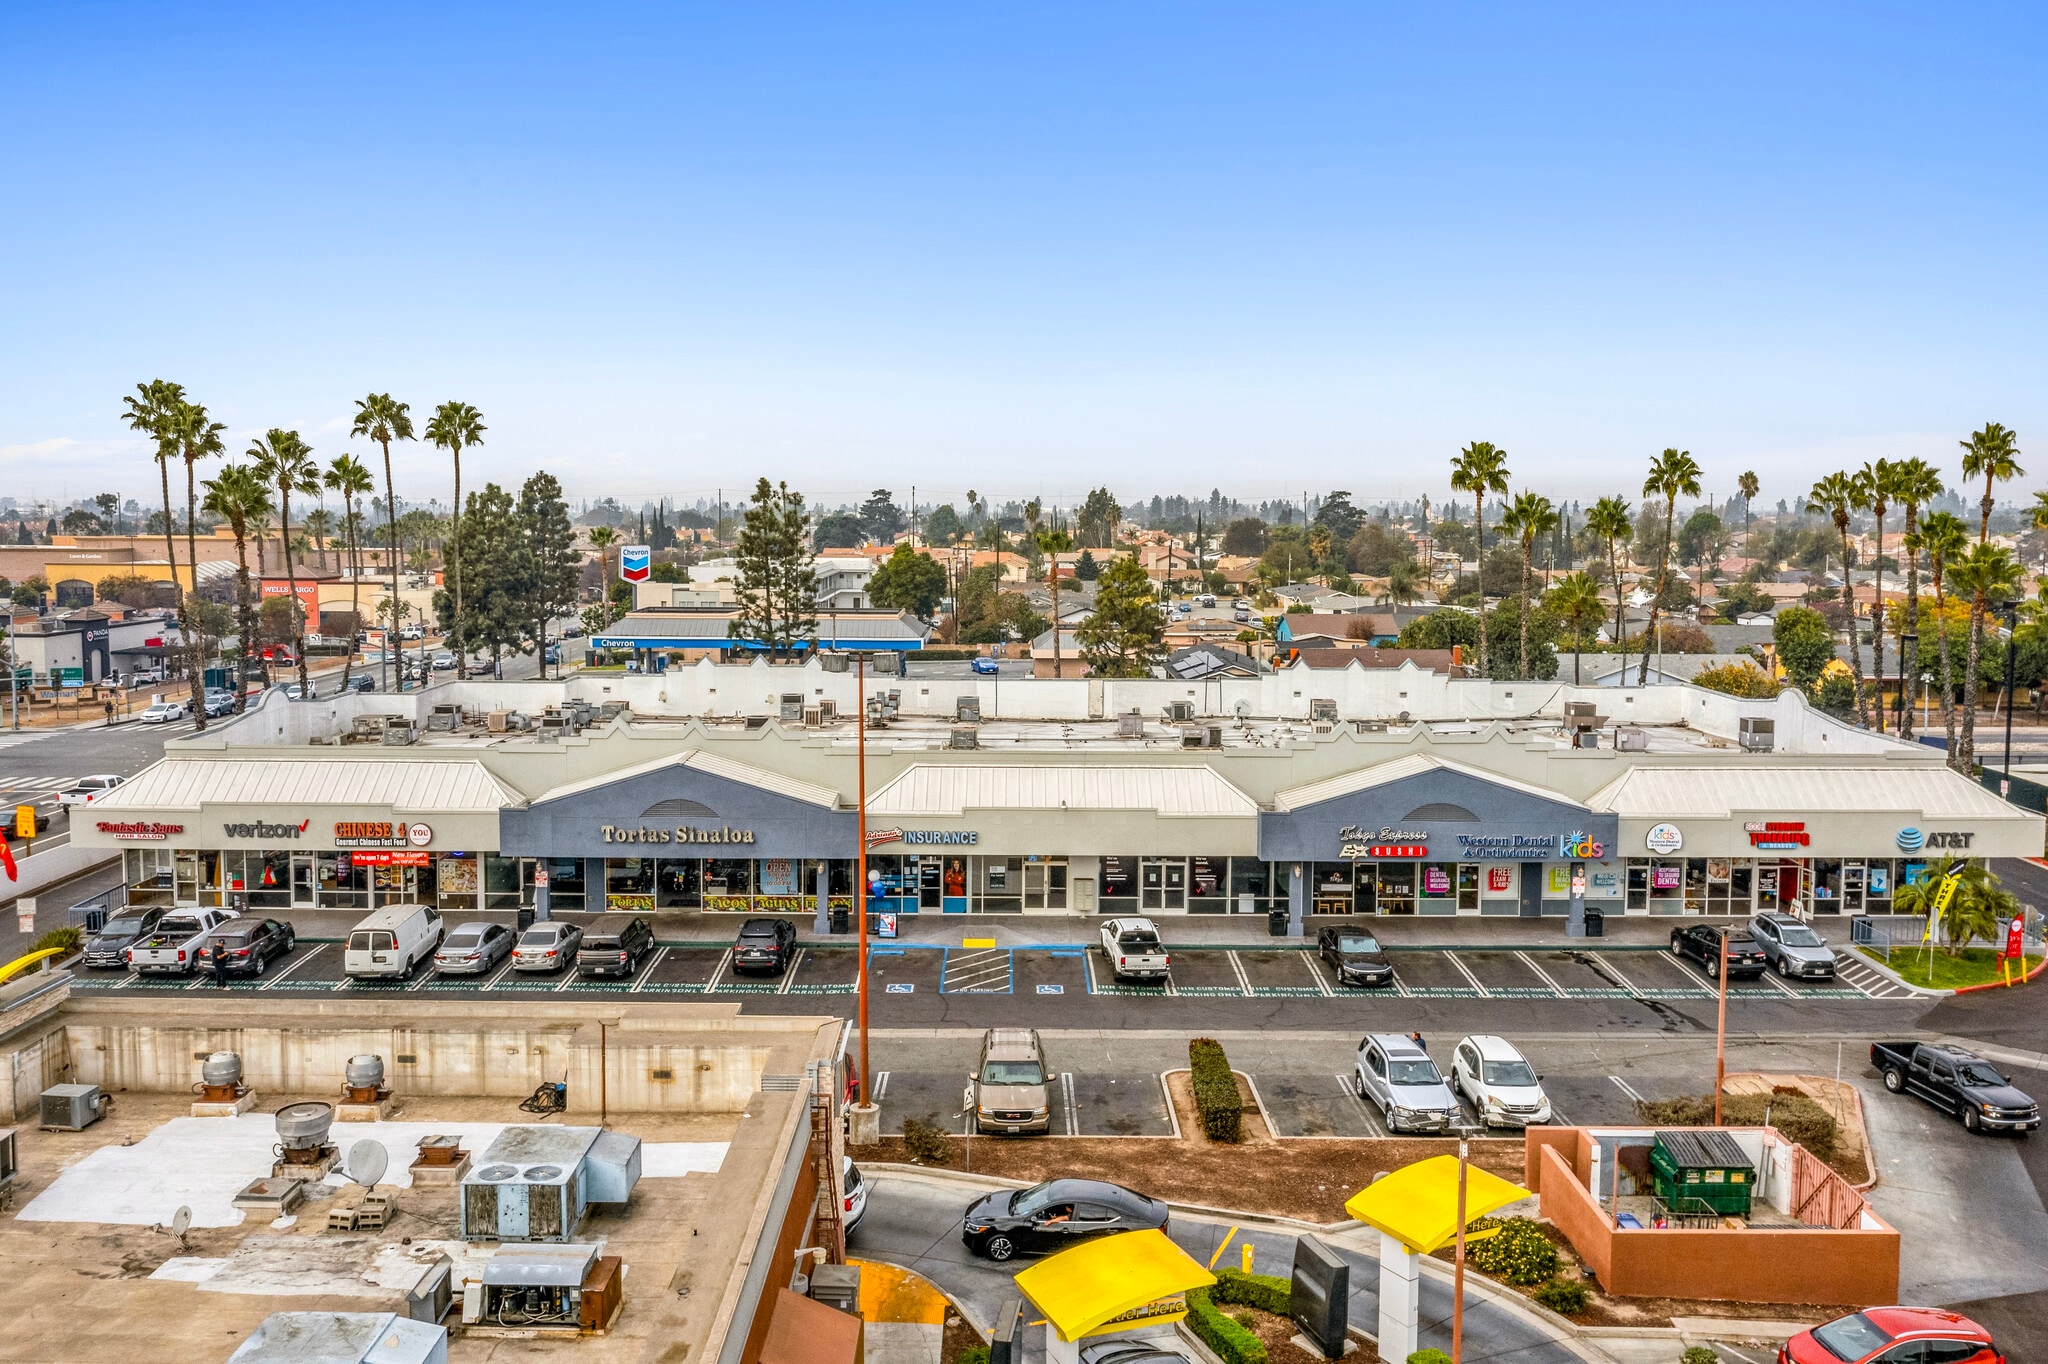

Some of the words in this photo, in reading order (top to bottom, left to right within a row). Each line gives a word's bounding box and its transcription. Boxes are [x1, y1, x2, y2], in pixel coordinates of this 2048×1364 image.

[602, 639, 634, 647] Chevron
[96, 822, 150, 834] Fantastic
[151, 822, 184, 834] Sams
[224, 820, 300, 838] verizon
[334, 822, 394, 838] CHINESE
[398, 822, 406, 838] 4
[1339, 825, 1376, 843] Tokyo
[1378, 826, 1428, 843] Express
[1654, 828, 1675, 840] kids
[601, 825, 670, 844] Tortas
[675, 826, 755, 844] Sinaloa
[904, 831, 977, 845] INSURANCE
[1456, 834, 1509, 846] Western
[1512, 834, 1556, 846] Dental
[1749, 832, 1810, 846] THREADING
[1926, 832, 1974, 848] AT&T
[1560, 832, 1604, 858] kids
[1374, 847, 1424, 856] SUSHI
[1462, 846, 1474, 857] &
[1476, 847, 1549, 858] Orthodontics
[766, 862, 792, 872] OPEN
[1494, 868, 1511, 876] FREE
[611, 898, 652, 907] TORTAS
[709, 899, 748, 908] TACOS
[760, 899, 798, 908] AGUAS
[1472, 1219, 1499, 1232] Here
[1148, 1302, 1184, 1317] Here
